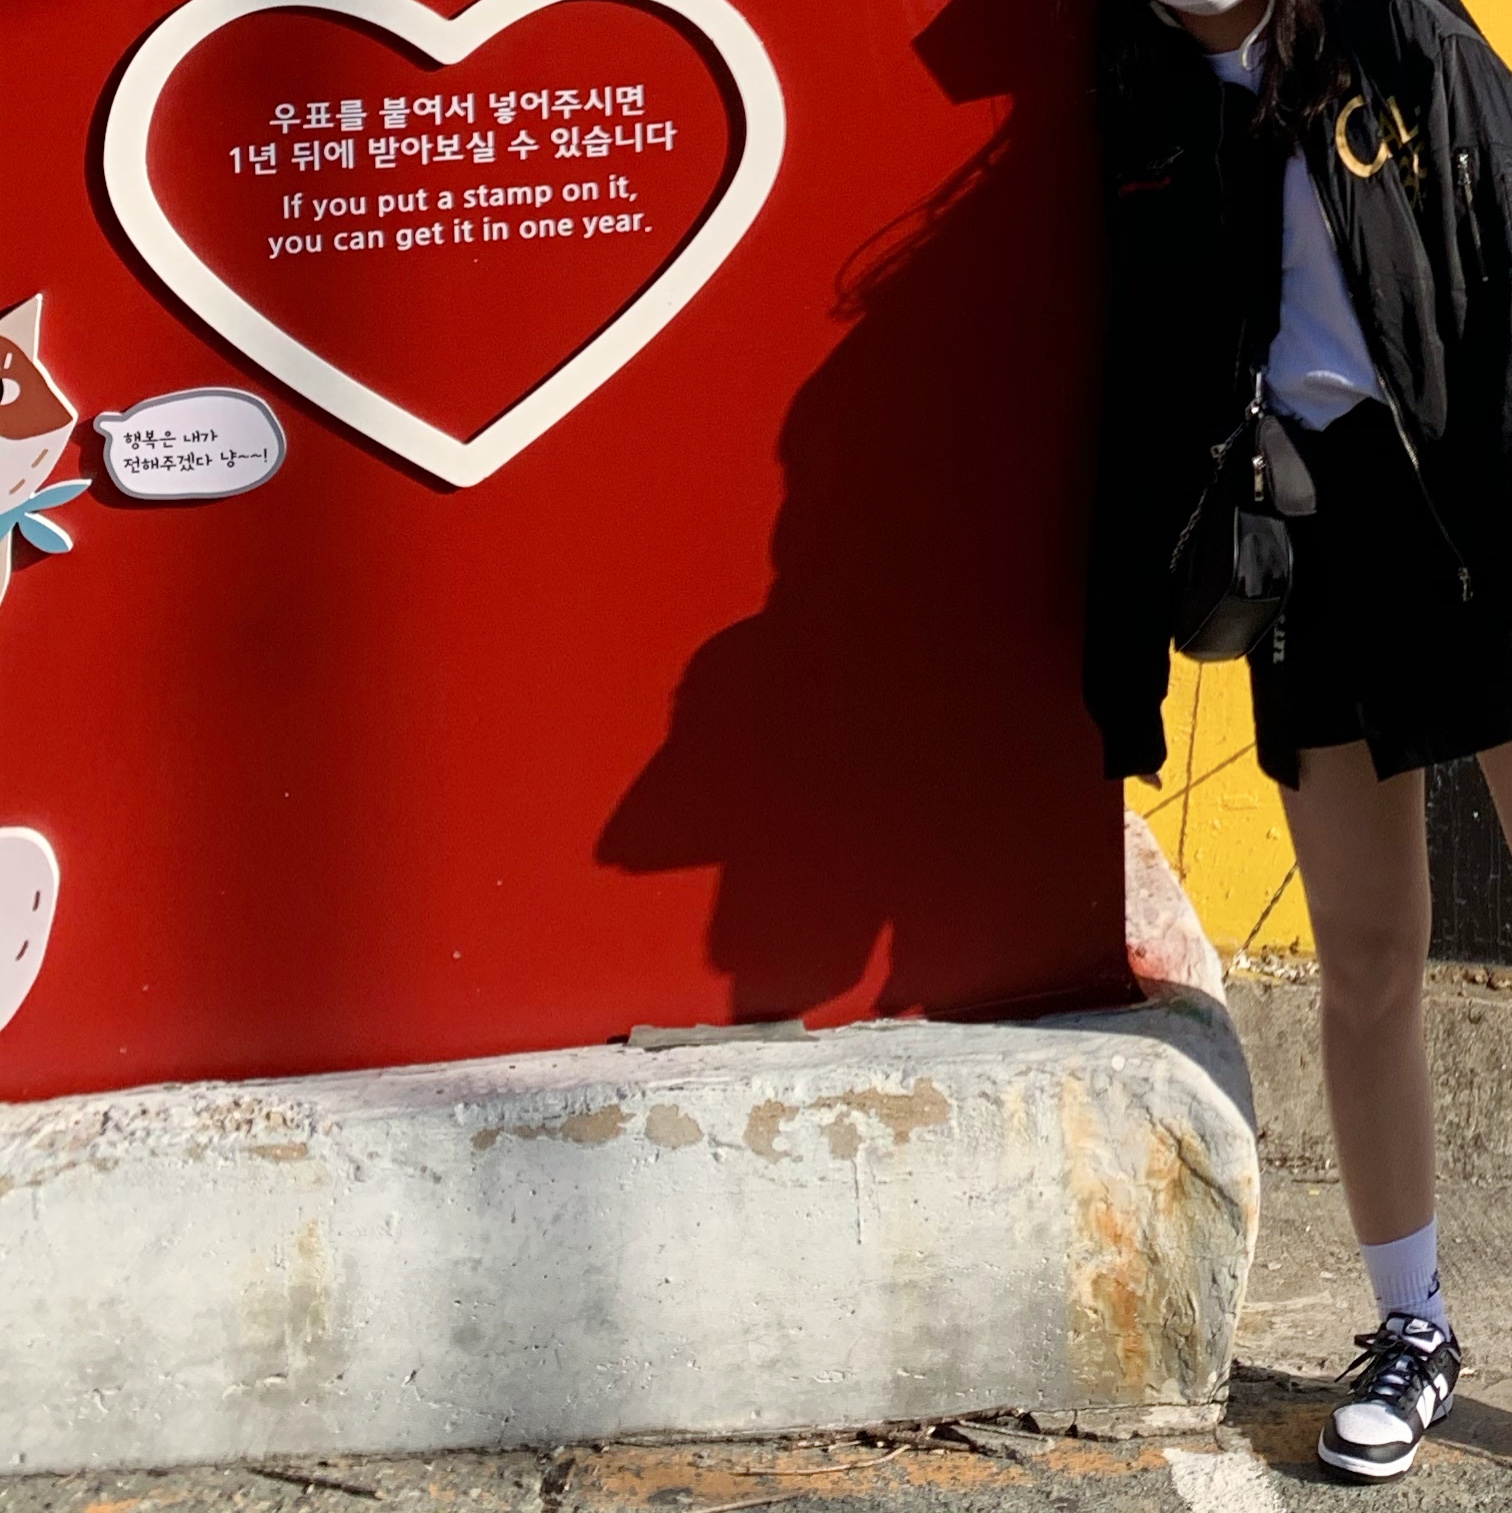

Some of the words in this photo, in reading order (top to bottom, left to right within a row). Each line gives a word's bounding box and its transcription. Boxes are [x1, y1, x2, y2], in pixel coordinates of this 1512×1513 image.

[269, 99, 368, 135] 우표를
[378, 92, 475, 130] 붙여서
[488, 84, 645, 126] 넣어주시면
[229, 142, 277, 176] 1년
[291, 138, 355, 172] 뒤에
[368, 130, 496, 169] 받아보실
[507, 129, 540, 161] 수
[550, 120, 678, 159] 있습니다
[283, 192, 303, 220] If
[312, 196, 367, 222] you
[378, 188, 429, 218] put
[437, 190, 454, 210] a
[463, 184, 553, 209] stamp
[562, 181, 599, 202] on
[608, 174, 638, 202] it,
[267, 234, 322, 260] you
[333, 230, 385, 251] can
[395, 222, 444, 251] get
[453, 218, 474, 244] it
[482, 216, 509, 242] in
[519, 217, 574, 239] one
[582, 212, 653, 239] year.
[123, 429, 177, 449] 행복은
[183, 428, 219, 443] 내가
[123, 451, 214, 474] 전해주겠다
